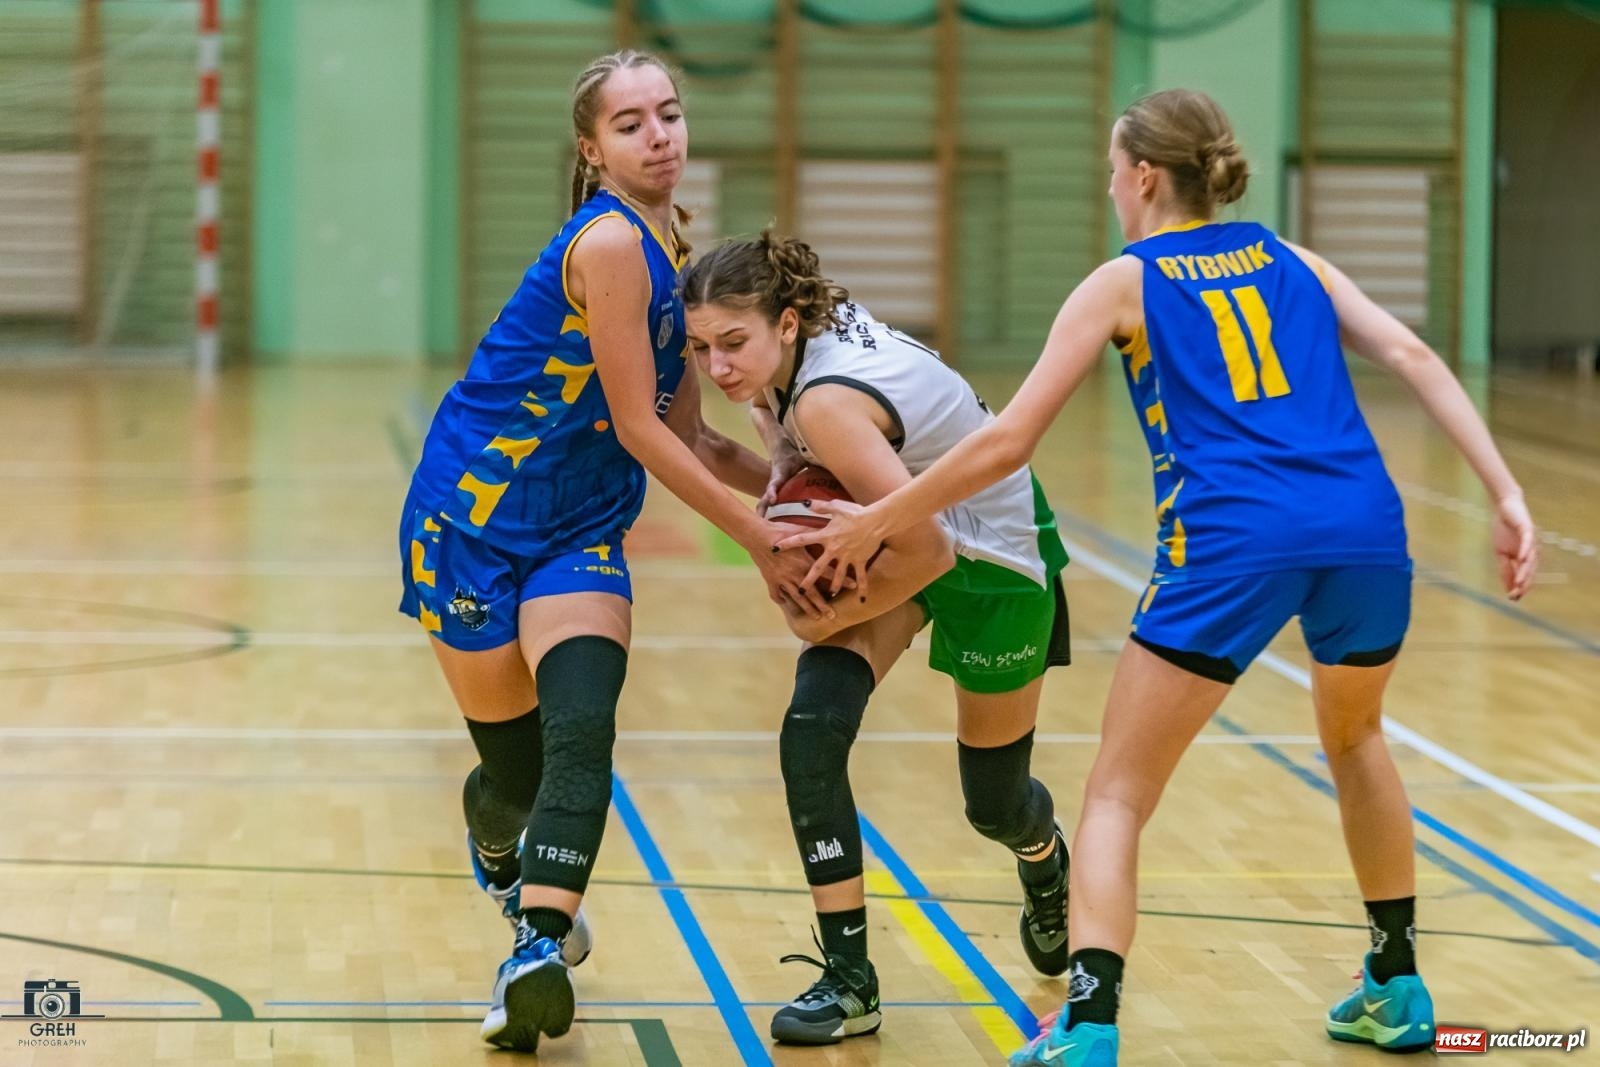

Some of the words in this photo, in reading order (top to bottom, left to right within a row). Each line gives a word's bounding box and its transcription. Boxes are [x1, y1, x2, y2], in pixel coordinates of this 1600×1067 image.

[1156, 240, 1274, 280] RYBNIK
[1200, 285, 1291, 402] 11
[996, 644, 1037, 668] studio
[815, 837, 845, 861] NBA
